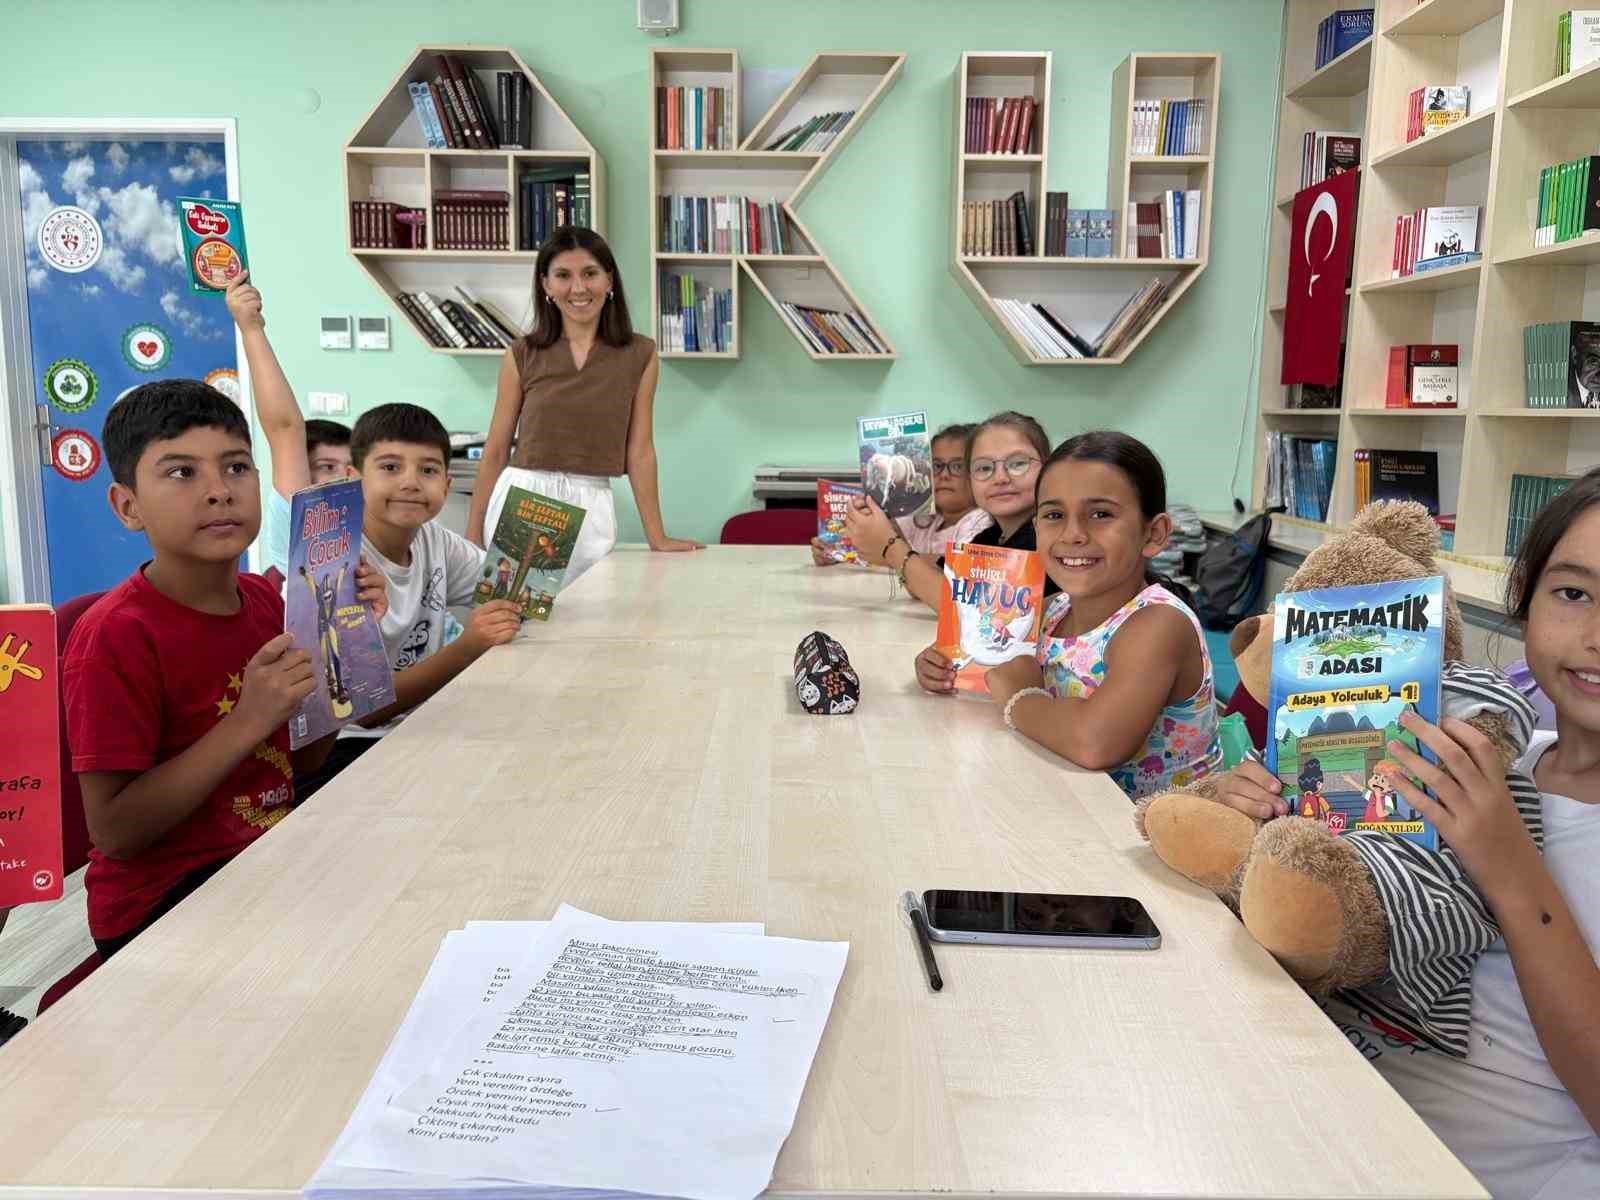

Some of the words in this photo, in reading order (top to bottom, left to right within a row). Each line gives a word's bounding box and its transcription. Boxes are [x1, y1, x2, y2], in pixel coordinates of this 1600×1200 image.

[1340, 14, 1372, 22] ERMEN
[303, 501, 340, 541] Bilim
[308, 529, 352, 573] Çocuk
[951, 577, 1032, 617] HAVUÇ
[1284, 593, 1430, 644] MATEMATİK
[1319, 656, 1382, 675] ADASI
[1291, 694, 1326, 708] Adaya
[1331, 689, 1383, 704] Yolculuk
[1356, 823, 1388, 833] DOĞAN
[1390, 824, 1424, 833] YILDIZ
[567, 938, 599, 949] Masal
[482, 1070, 525, 1081] çıkalım
[455, 1077, 480, 1087] Yem
[482, 1080, 527, 1091] verelim
[529, 1085, 574, 1098] ördeğe
[484, 1091, 528, 1103] yemini
[529, 1098, 588, 1110] yemeden
[511, 1103, 572, 1118] demeden
